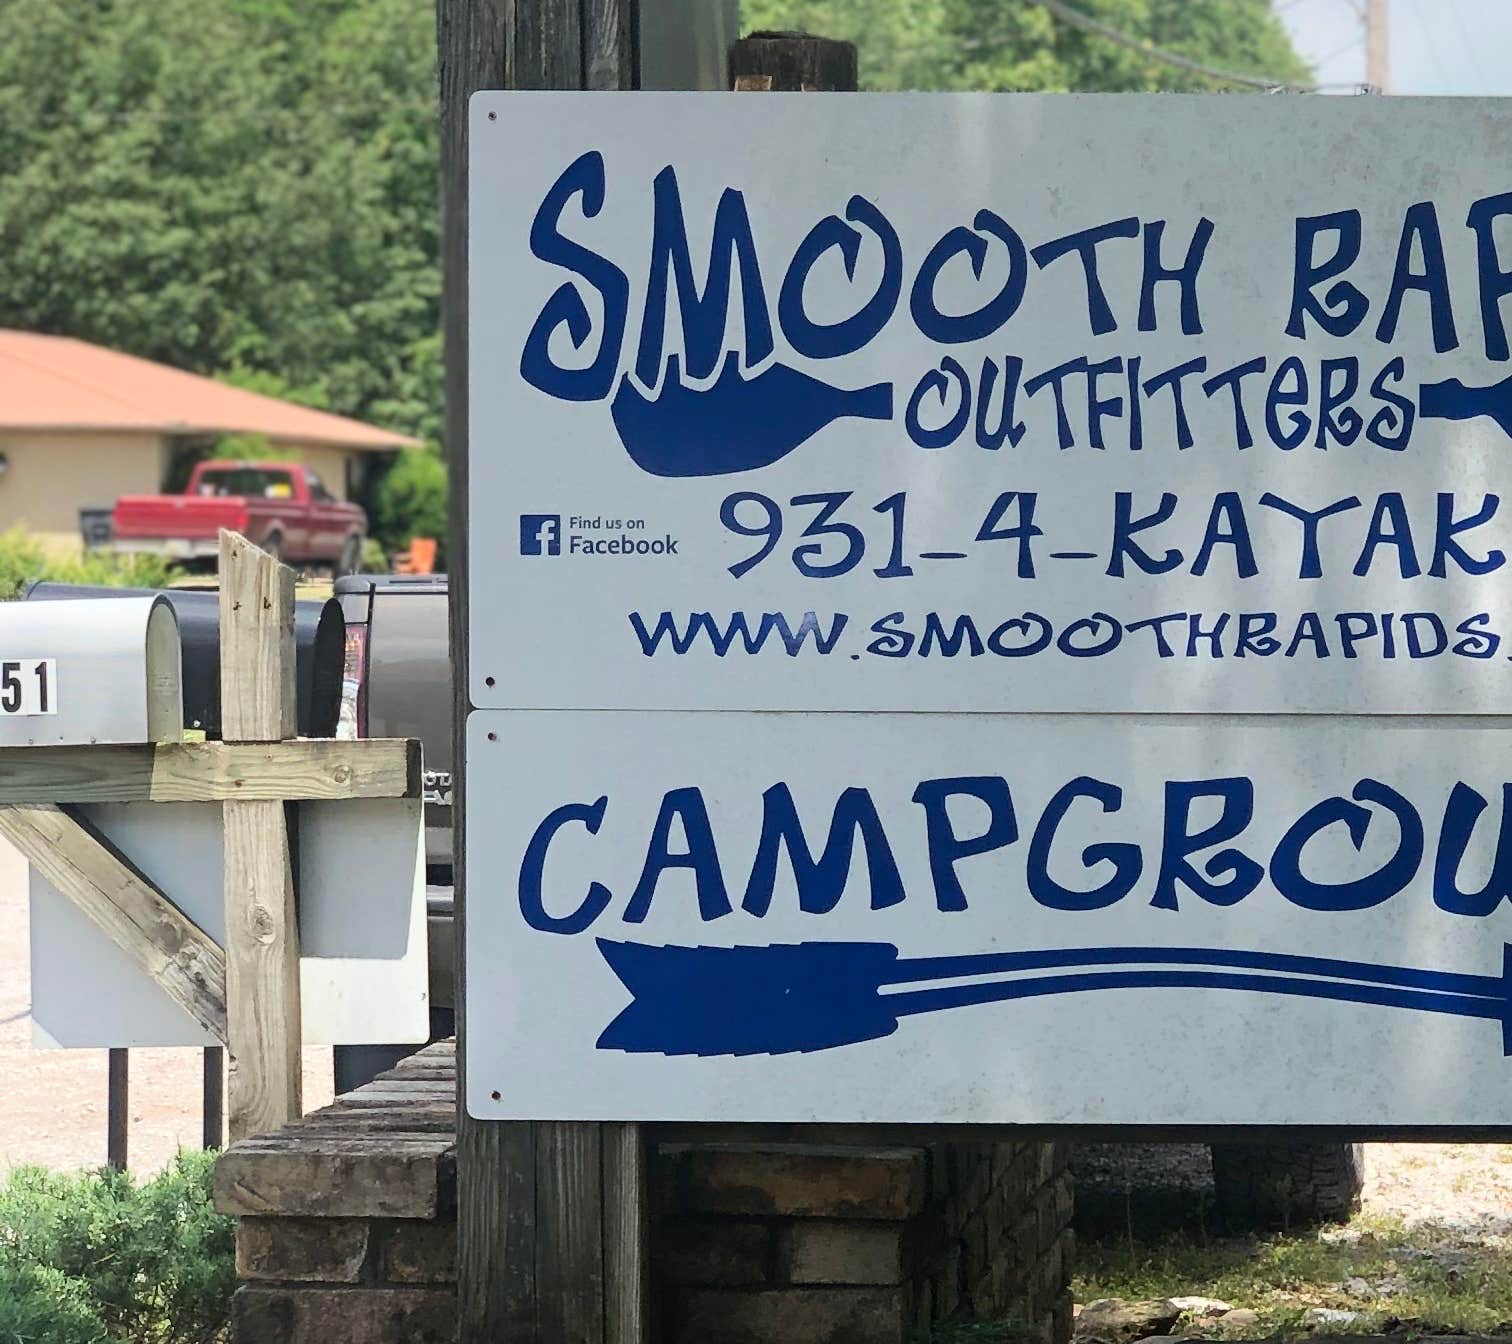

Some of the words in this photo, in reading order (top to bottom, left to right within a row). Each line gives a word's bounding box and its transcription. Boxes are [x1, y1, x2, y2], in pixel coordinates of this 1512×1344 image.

[520, 150, 1214, 402] SMOOTH
[905, 355, 1416, 452] OUTFITTERS
[569, 516, 601, 529] Find
[605, 519, 622, 529] us
[626, 519, 645, 529] on
[569, 534, 679, 555] Facebook
[2, 661, 48, 713] 51
